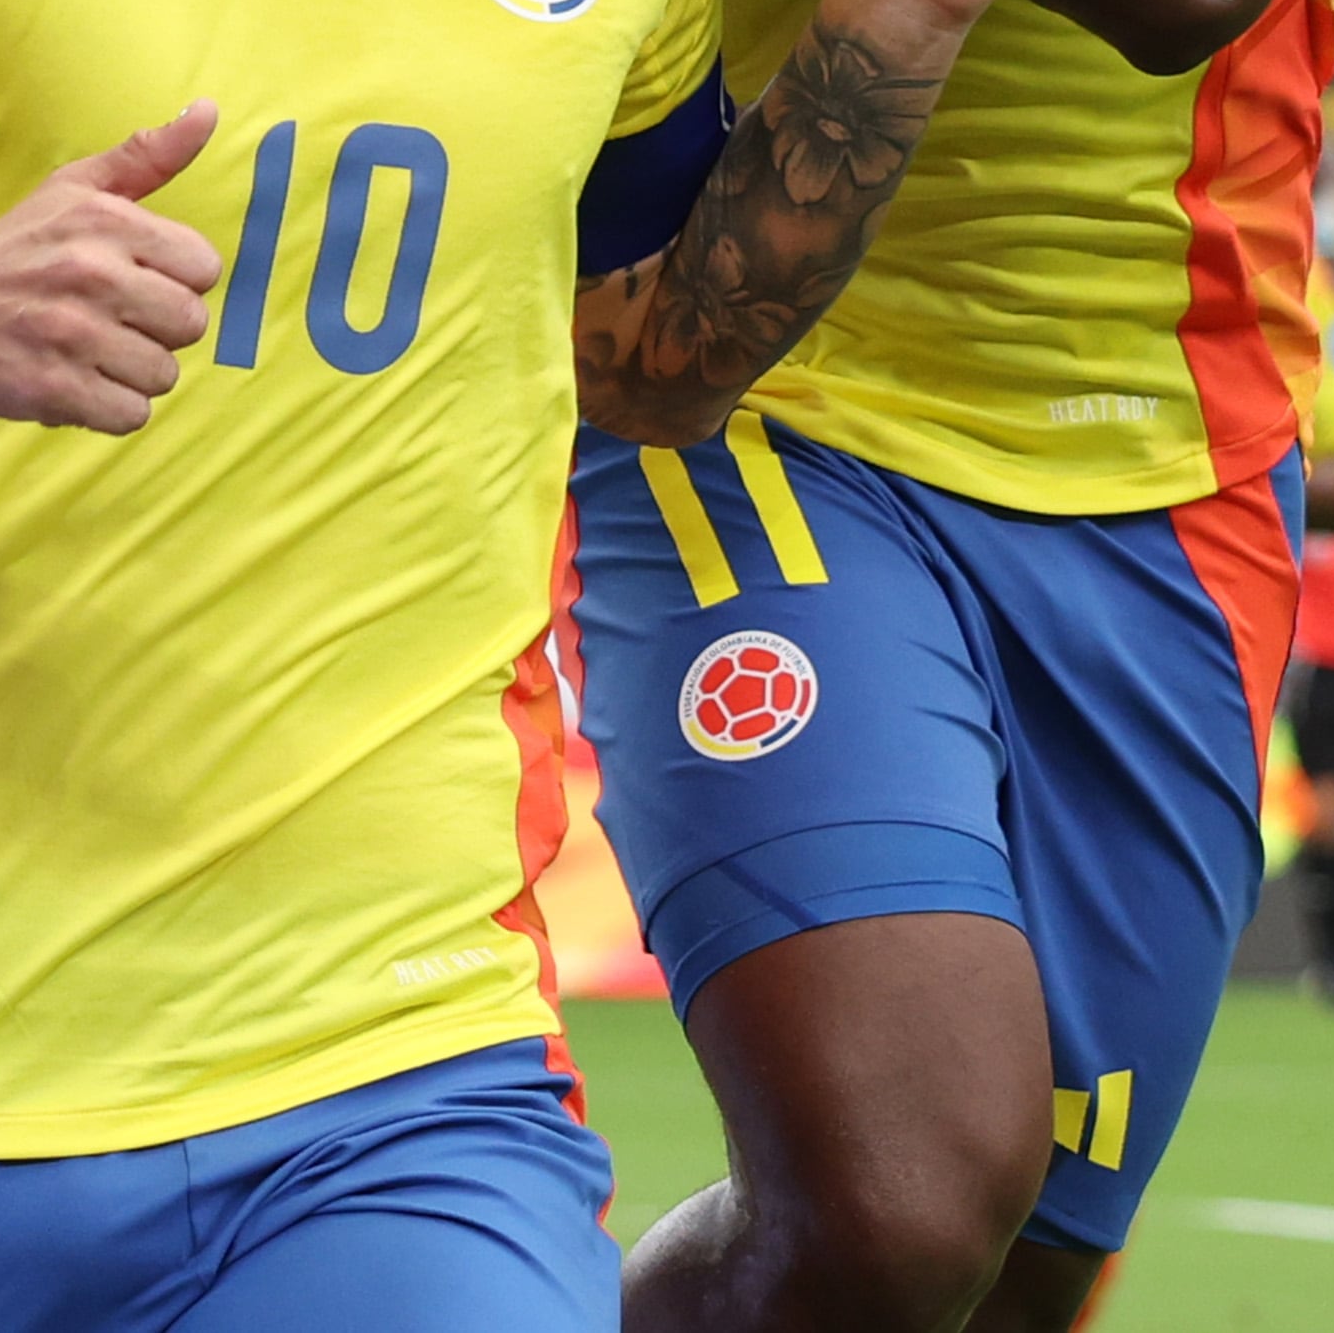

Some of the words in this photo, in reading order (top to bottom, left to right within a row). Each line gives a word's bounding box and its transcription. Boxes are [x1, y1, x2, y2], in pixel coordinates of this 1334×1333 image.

[214, 120, 449, 375] 10
[639, 409, 829, 609] 11
[704, 635, 768, 663] COLOMBIANA
